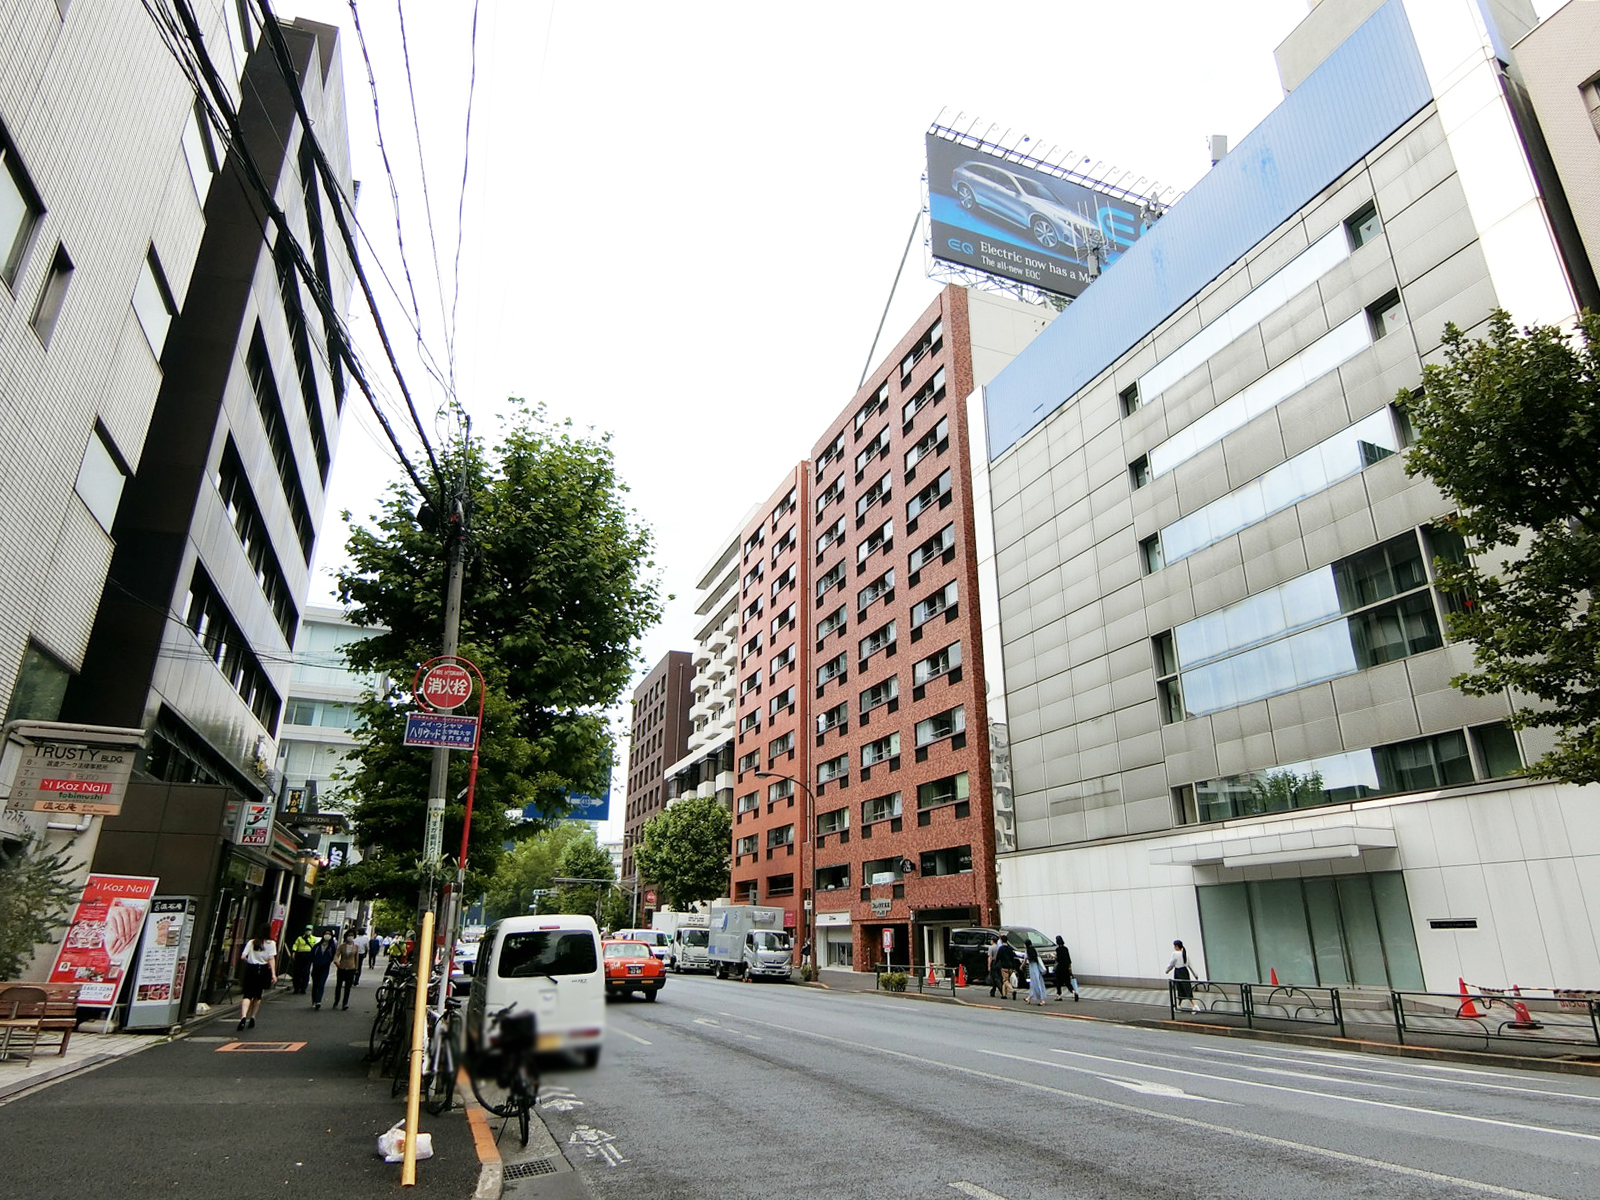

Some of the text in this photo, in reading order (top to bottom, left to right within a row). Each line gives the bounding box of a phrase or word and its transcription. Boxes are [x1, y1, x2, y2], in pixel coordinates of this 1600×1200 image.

[947, 238, 975, 256] EQ
[980, 241, 1022, 263] Electric
[1024, 257, 1046, 270] now
[1049, 262, 1068, 276] has
[981, 255, 1040, 280] The all-new EQC
[427, 677, 468, 696] 消火栓
[409, 726, 441, 739] ハリウッド
[34, 745, 122, 763] TRUSTY BLDG.
[82, 784, 107, 792] Nail
[102, 883, 123, 892] Koz
[126, 884, 149, 893] Nail
